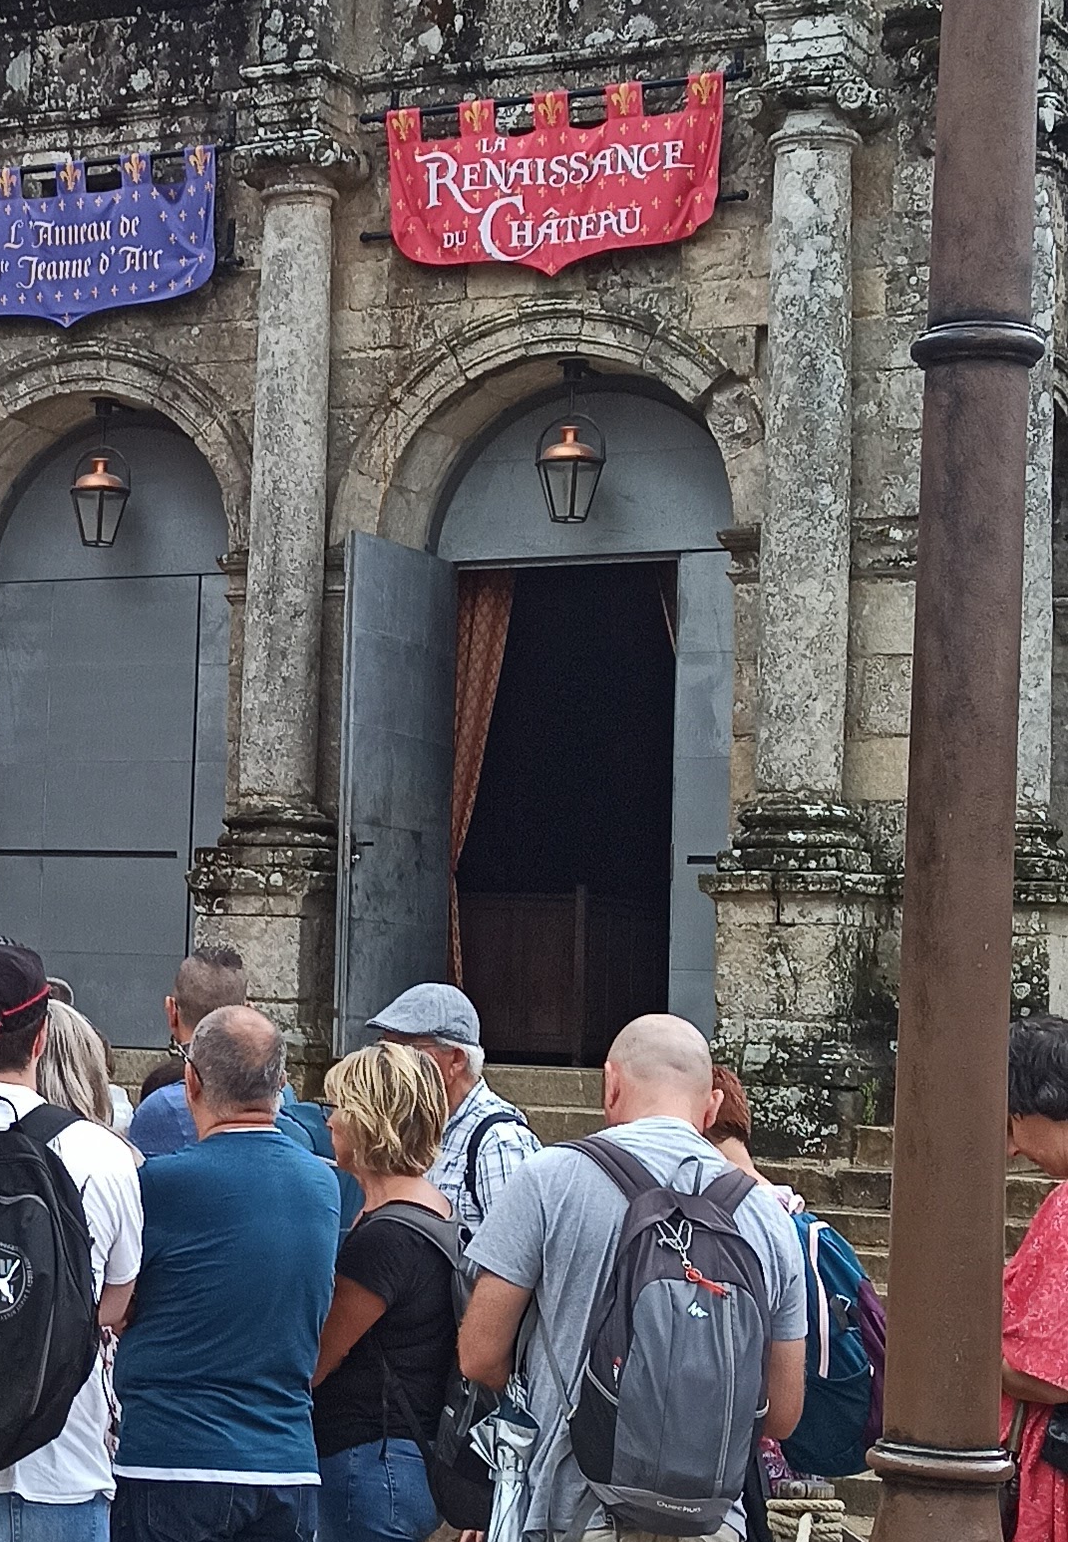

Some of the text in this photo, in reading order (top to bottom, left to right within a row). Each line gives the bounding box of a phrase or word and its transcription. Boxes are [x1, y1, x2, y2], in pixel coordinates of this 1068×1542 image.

[482, 136, 508, 154] LA
[414, 139, 696, 215] RENAISSANCE
[119, 213, 141, 238] de
[442, 194, 644, 263] DU CHÂTEAU
[15, 257, 93, 290] Jeanne
[98, 244, 163, 275] d'Arc
